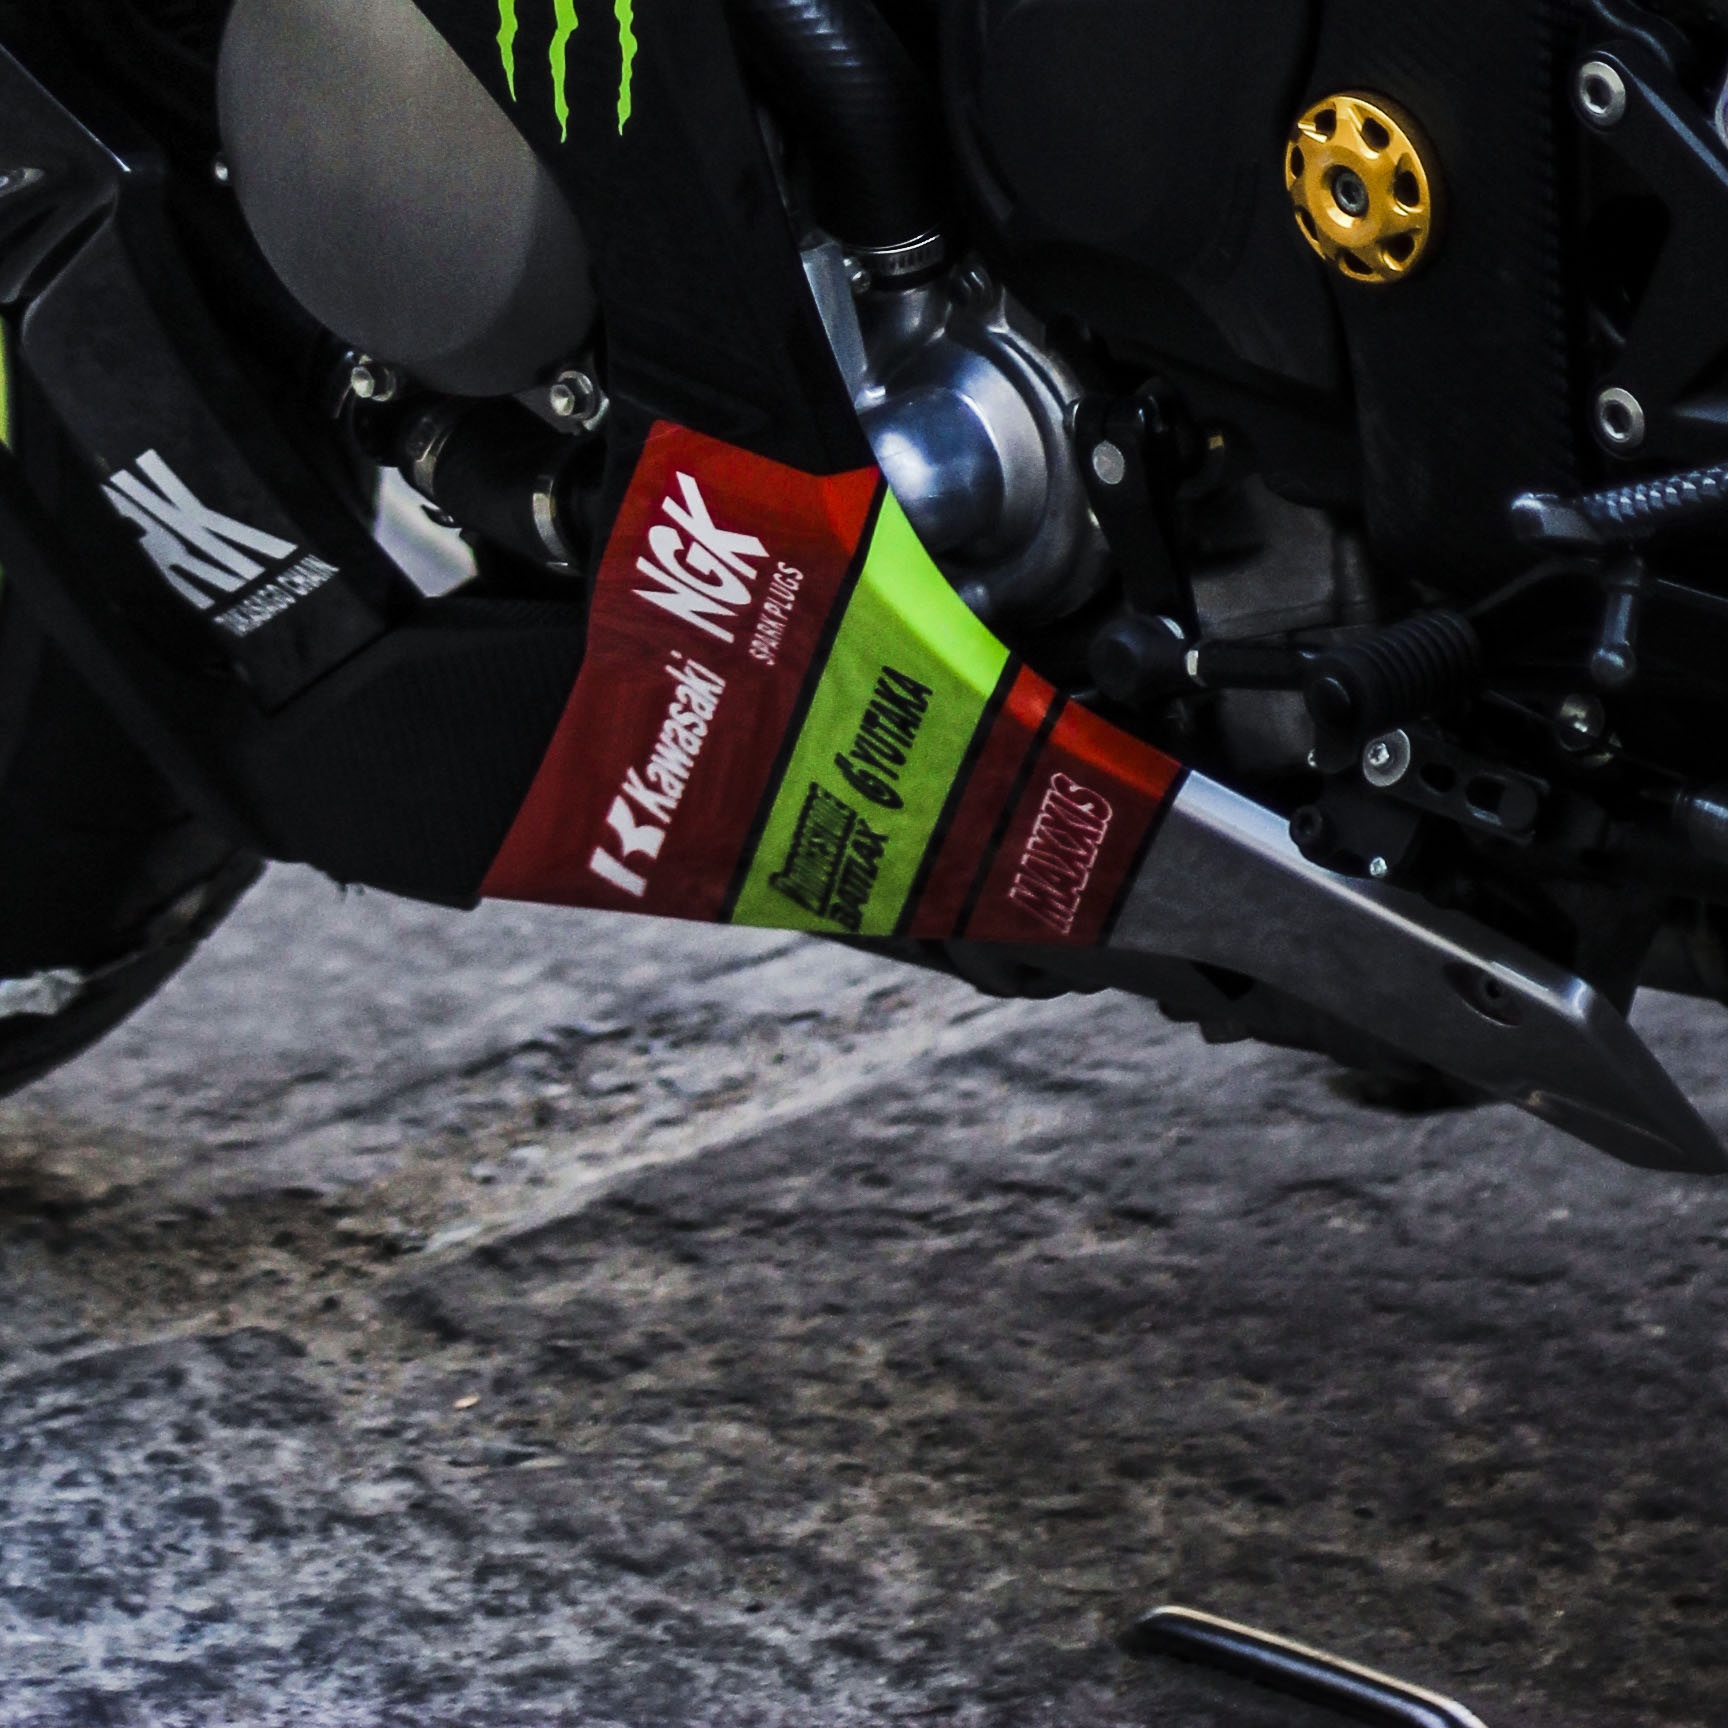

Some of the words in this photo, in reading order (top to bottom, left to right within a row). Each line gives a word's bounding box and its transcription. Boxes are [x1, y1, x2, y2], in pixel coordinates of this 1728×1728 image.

[632, 471, 770, 643] NGK
[765, 561, 804, 621] PLUGS
[748, 613, 784, 665] SPARK
[623, 651, 726, 826] Kawasaki
[1010, 772, 1113, 935] MAXXIS
